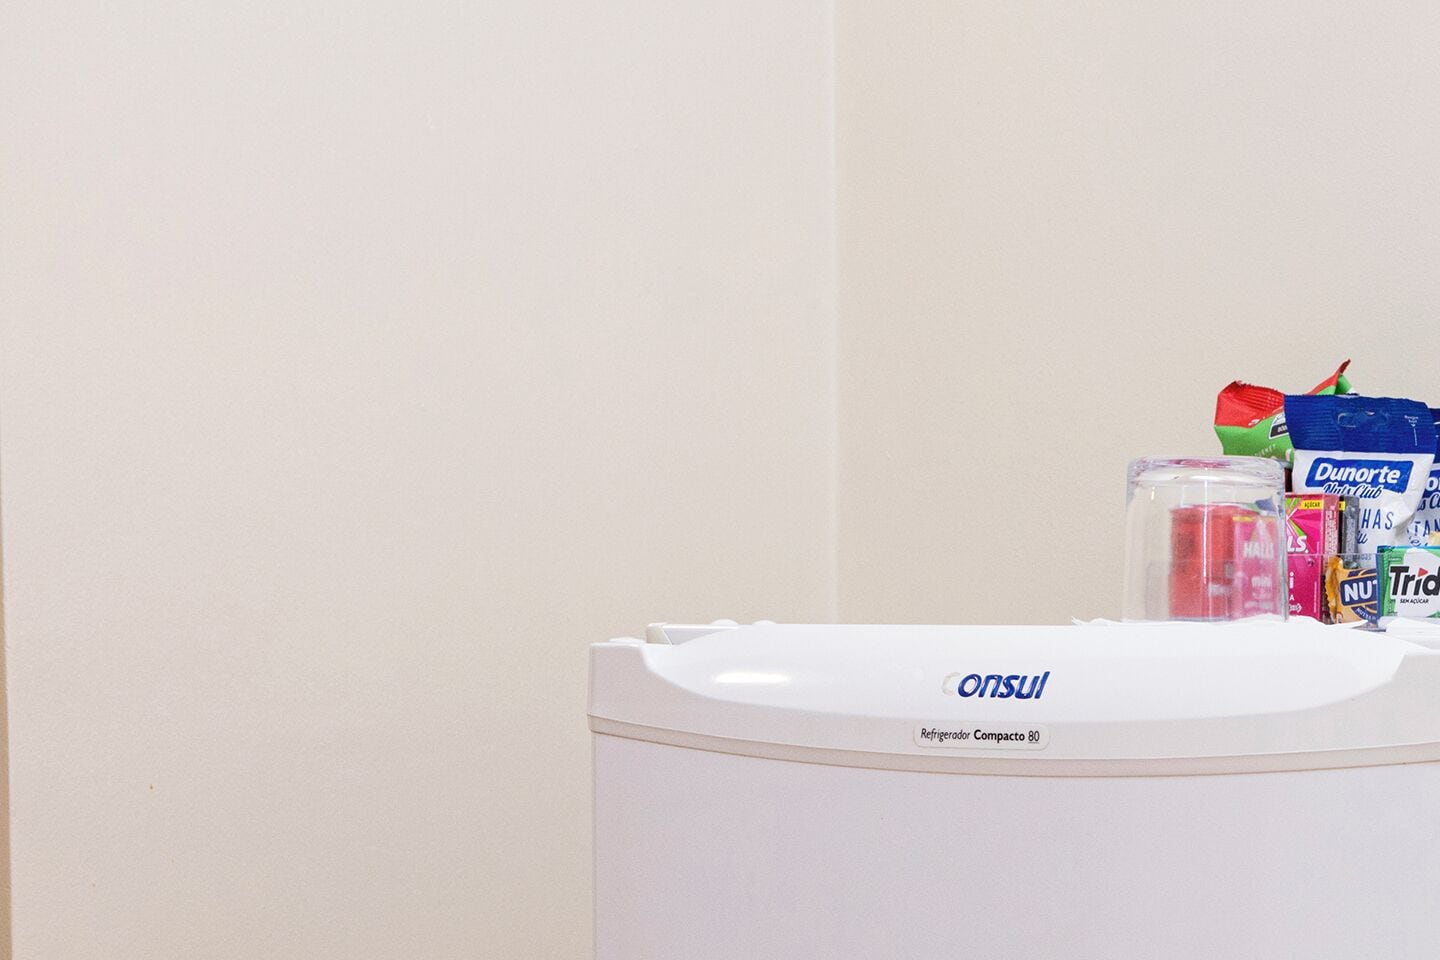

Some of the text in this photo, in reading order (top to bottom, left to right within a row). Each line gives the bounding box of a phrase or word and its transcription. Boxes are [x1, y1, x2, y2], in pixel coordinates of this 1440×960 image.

[1314, 462, 1401, 484] Dunorte
[1352, 482, 1384, 499] Club
[920, 727, 1040, 743] Refrigerador Compacto 80
